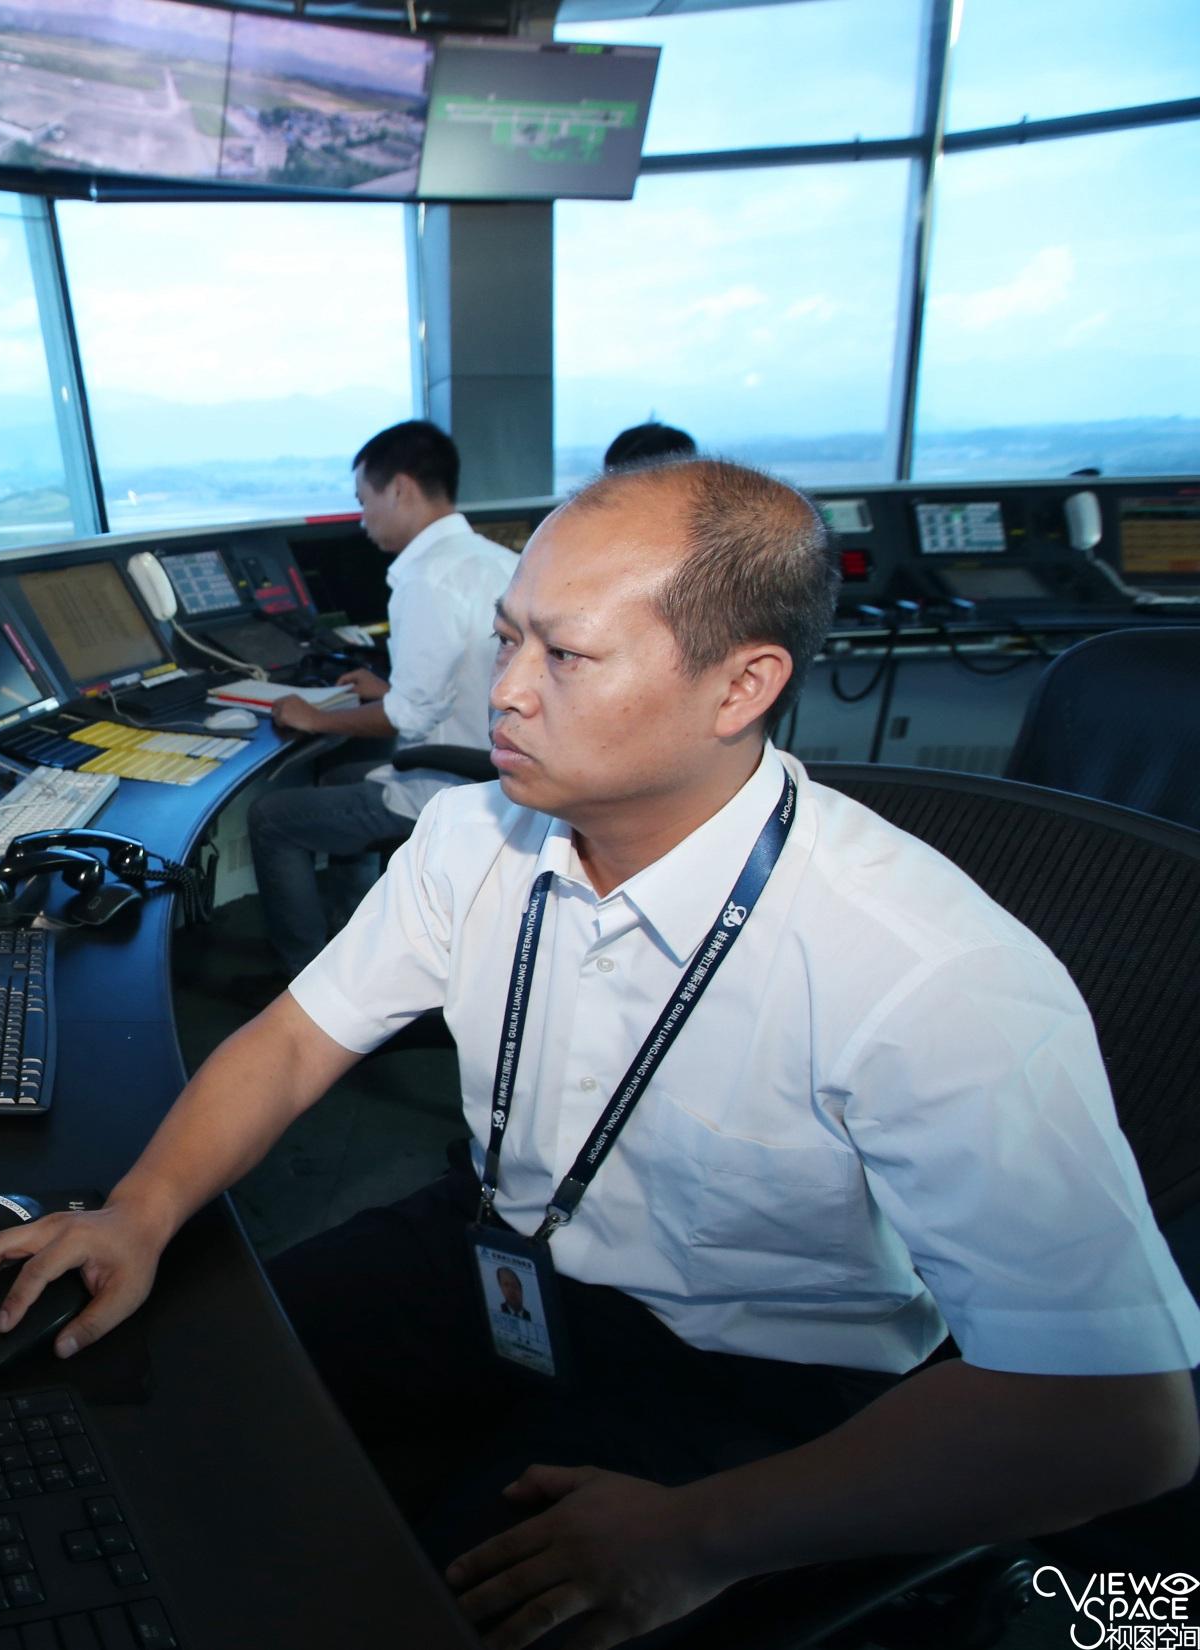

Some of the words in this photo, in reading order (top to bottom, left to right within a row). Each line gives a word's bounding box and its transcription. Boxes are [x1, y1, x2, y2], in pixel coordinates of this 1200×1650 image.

[522, 898, 540, 962] INTERNATIONAL
[513, 963, 528, 1011] LIANGJIANG
[679, 931, 730, 1002] 桂林两江国际机场
[509, 1012, 519, 1038] GUILIN
[665, 1003, 685, 1030] GUILIN
[637, 1031, 669, 1076] LIANGJIANG
[605, 1076, 641, 1132] INTERNATIONAL
[587, 1134, 609, 1165] AIRPORT
